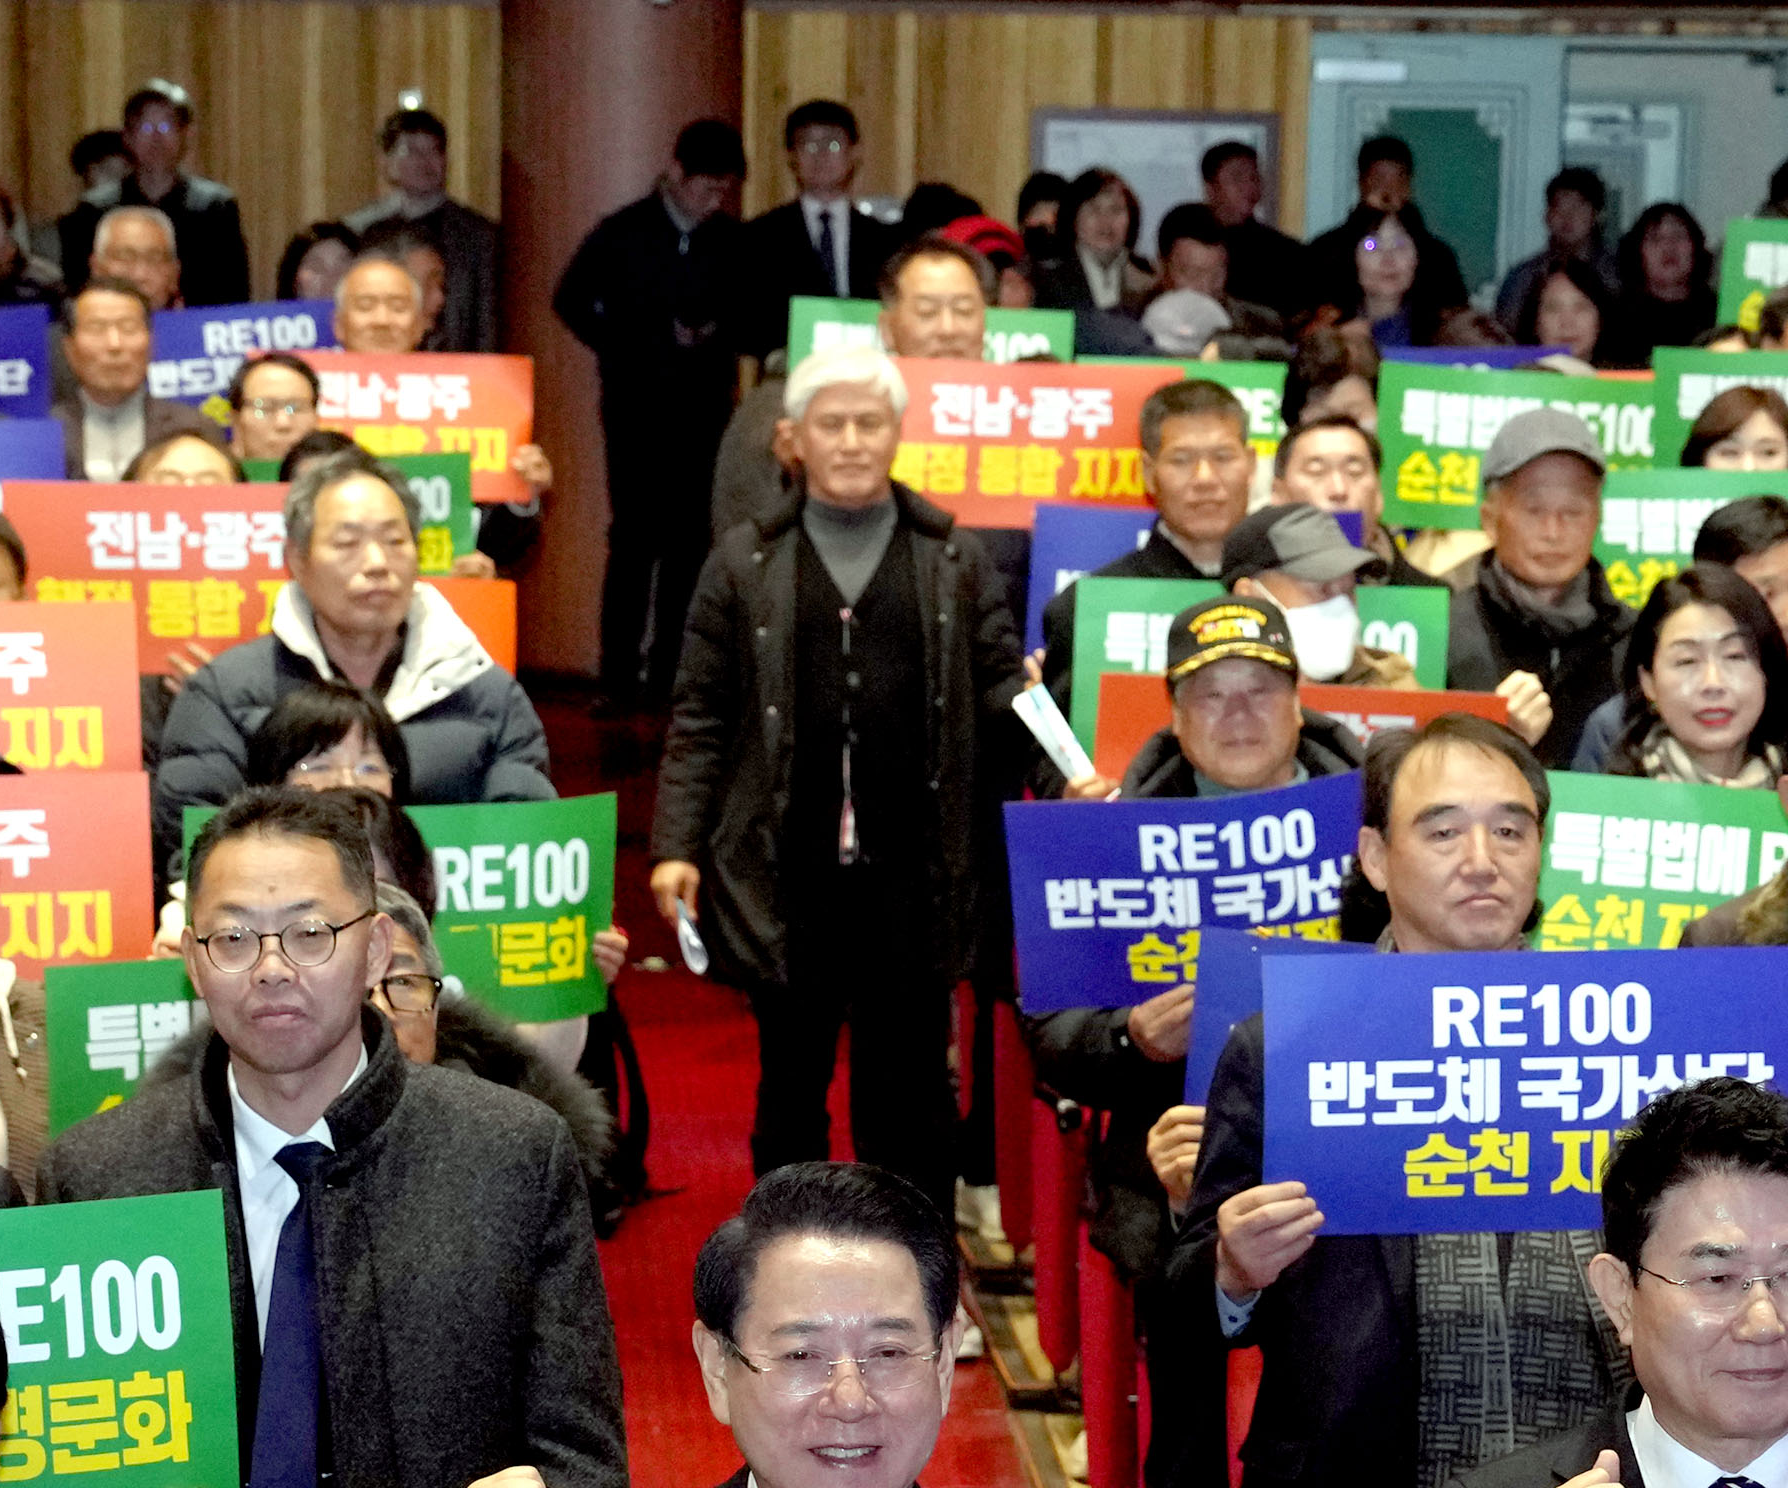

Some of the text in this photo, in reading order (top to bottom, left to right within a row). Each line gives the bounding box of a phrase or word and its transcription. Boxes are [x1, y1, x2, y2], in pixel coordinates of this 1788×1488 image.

[203, 314, 317, 356] RE100
[929, 383, 1113, 439] 전남·광주
[978, 444, 1063, 497] 통합
[1396, 451, 1481, 506] 순천
[85, 509, 290, 569] 전남·광주
[146, 575, 241, 638] 통합
[2, 705, 104, 770] 지지
[1138, 809, 1316, 872] RE100
[1548, 811, 1748, 896] 특별법에
[0, 891, 113, 962] 지지
[1046, 877, 1200, 930] 반도체
[1544, 893, 1649, 952] 순천
[1431, 982, 1652, 1048] RE100
[1308, 1056, 1502, 1128] 반도체
[1403, 1130, 1529, 1198] 순천
